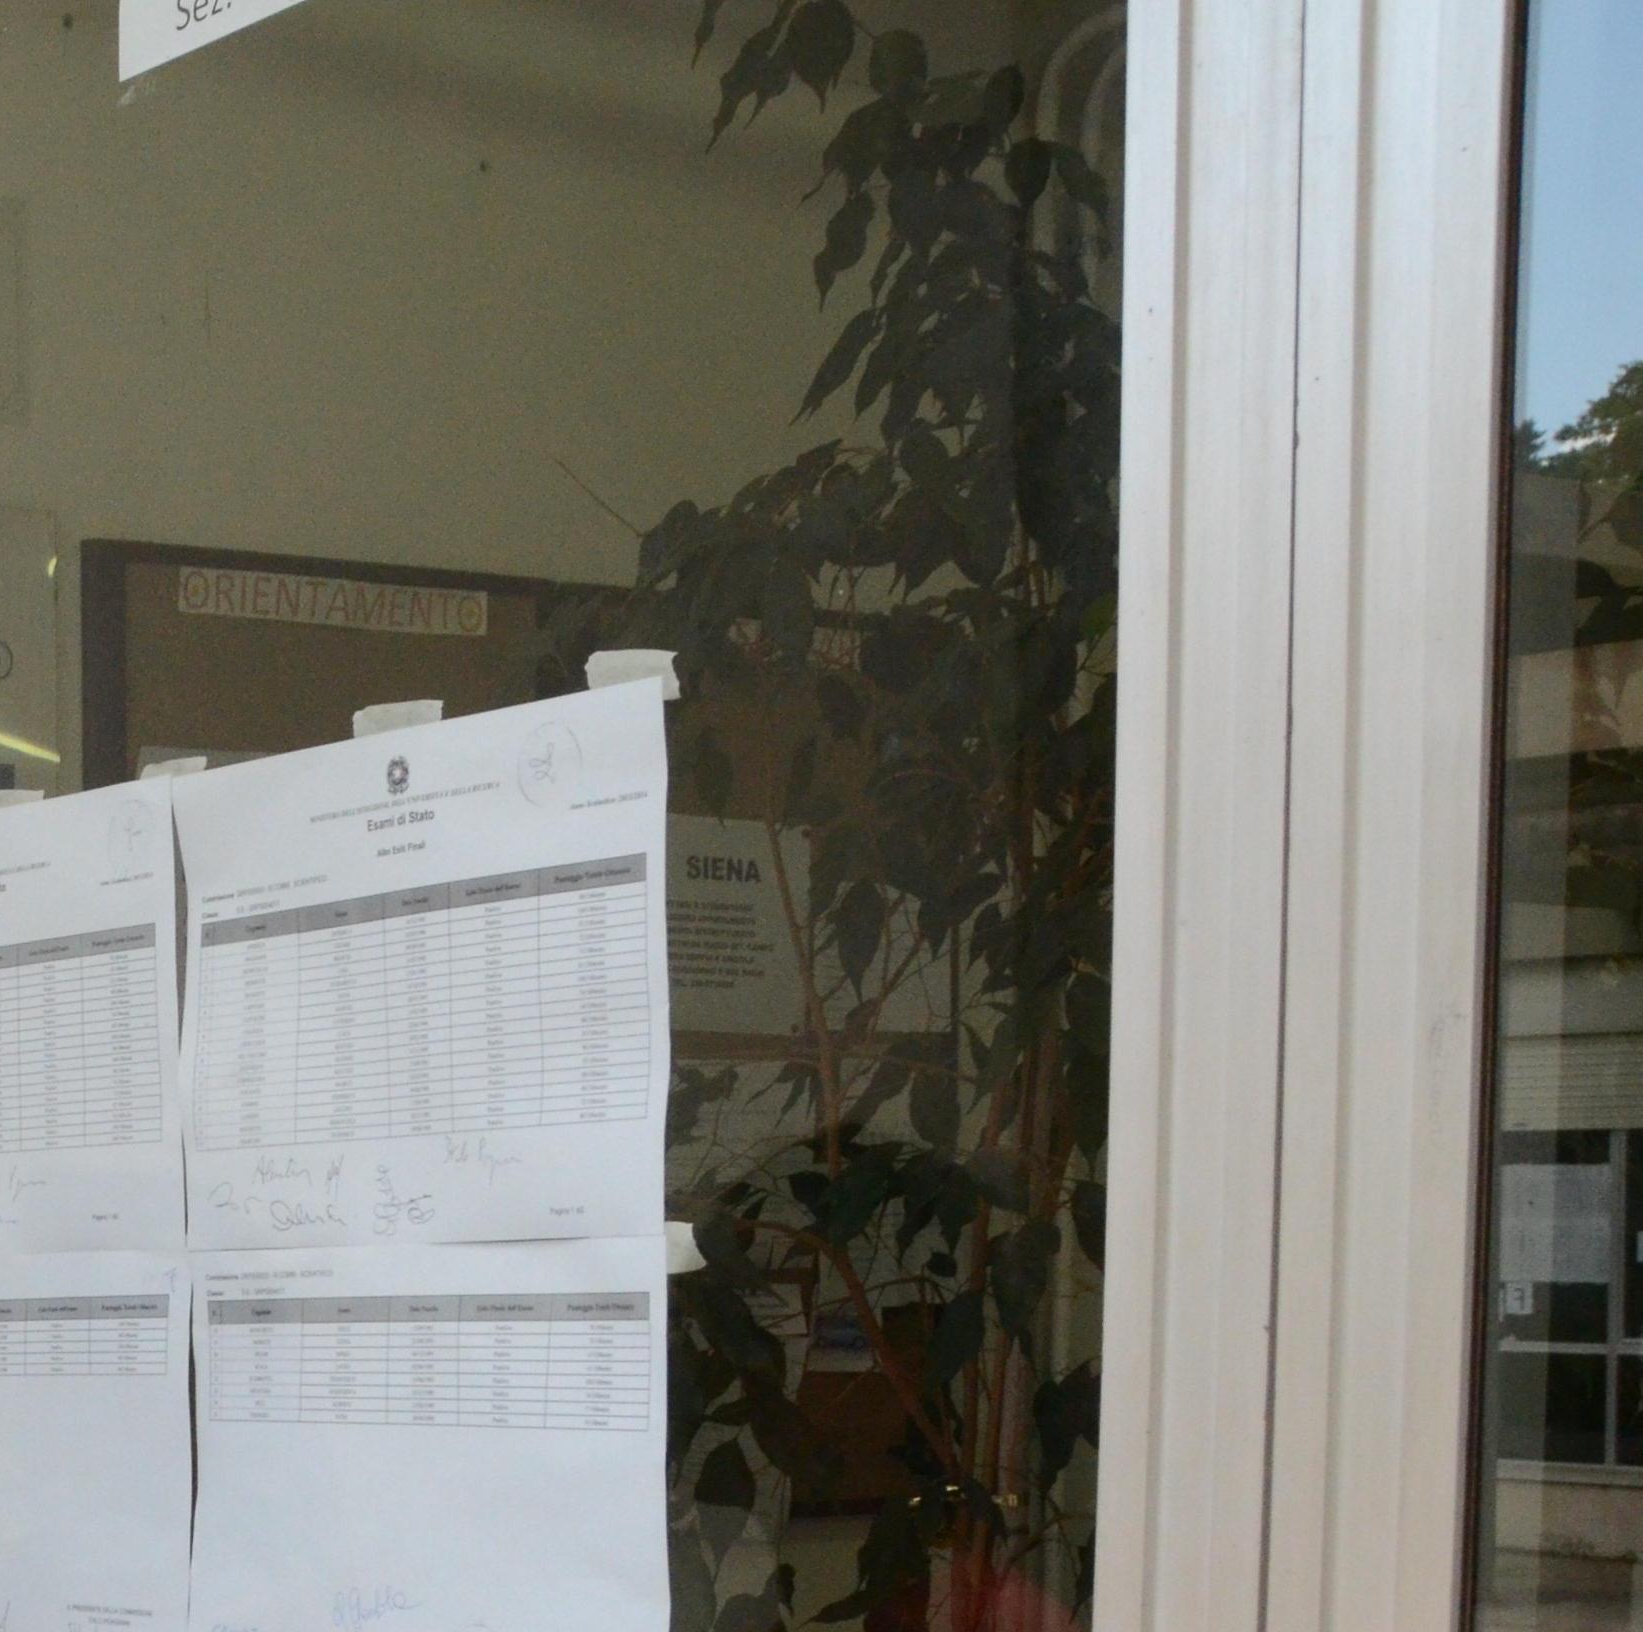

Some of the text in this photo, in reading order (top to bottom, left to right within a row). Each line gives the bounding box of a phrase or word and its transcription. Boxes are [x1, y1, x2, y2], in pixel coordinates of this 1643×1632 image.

[182, 569, 483, 633] ORIENTAMENTO
[366, 817, 396, 833] Esami
[408, 808, 436, 825] Stato
[686, 855, 762, 883] SIENA
